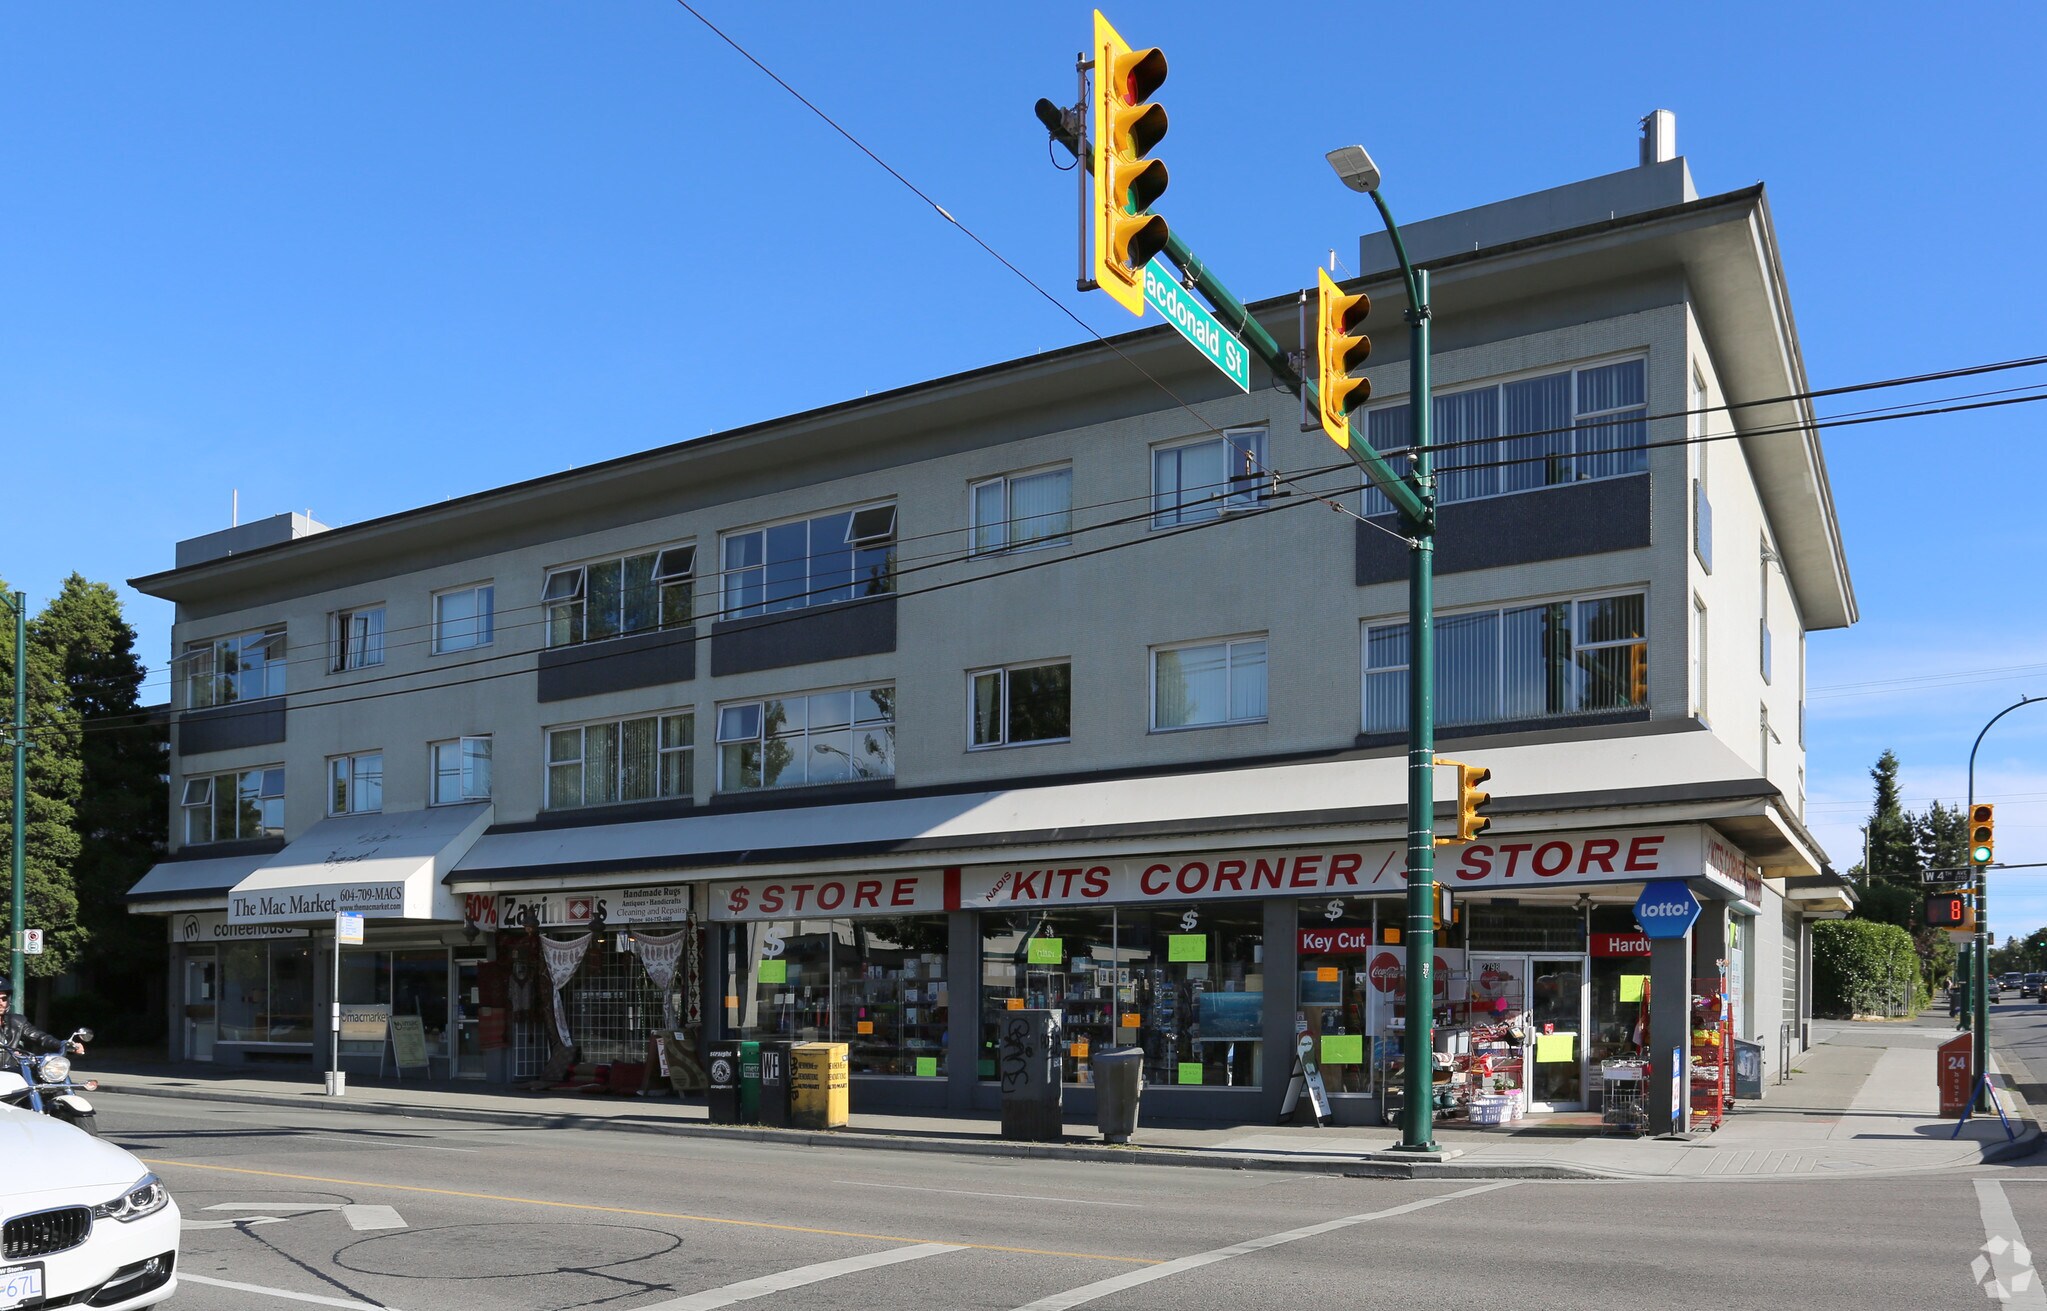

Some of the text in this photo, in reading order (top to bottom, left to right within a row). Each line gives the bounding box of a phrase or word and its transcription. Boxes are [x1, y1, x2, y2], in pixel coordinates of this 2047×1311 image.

[1144, 265, 1242, 378] acdonald St
[985, 871, 1012, 902] NADIS
[1010, 866, 1111, 900] KITS
[1140, 853, 1363, 895] CORNER
[1456, 836, 1665, 881] STORE
[1925, 872, 1934, 881] W
[1937, 871, 1952, 880] 4TH
[340, 886, 402, 902] 604-709-MACS
[623, 887, 681, 898] Handmade Rugs
[728, 878, 919, 915] $ STORE
[233, 893, 336, 917] The Mac Market
[339, 903, 401, 912] www.themacmarket.com
[465, 894, 496, 925] 50%
[649, 898, 681, 906] Handicrafts
[1641, 901, 1689, 917] lotto!
[1951, 900, 1960, 920] 8
[617, 906, 686, 917] Cleaning and Repairs
[1303, 932, 1366, 952] Key Cut
[1948, 1056, 1965, 1069] 24
